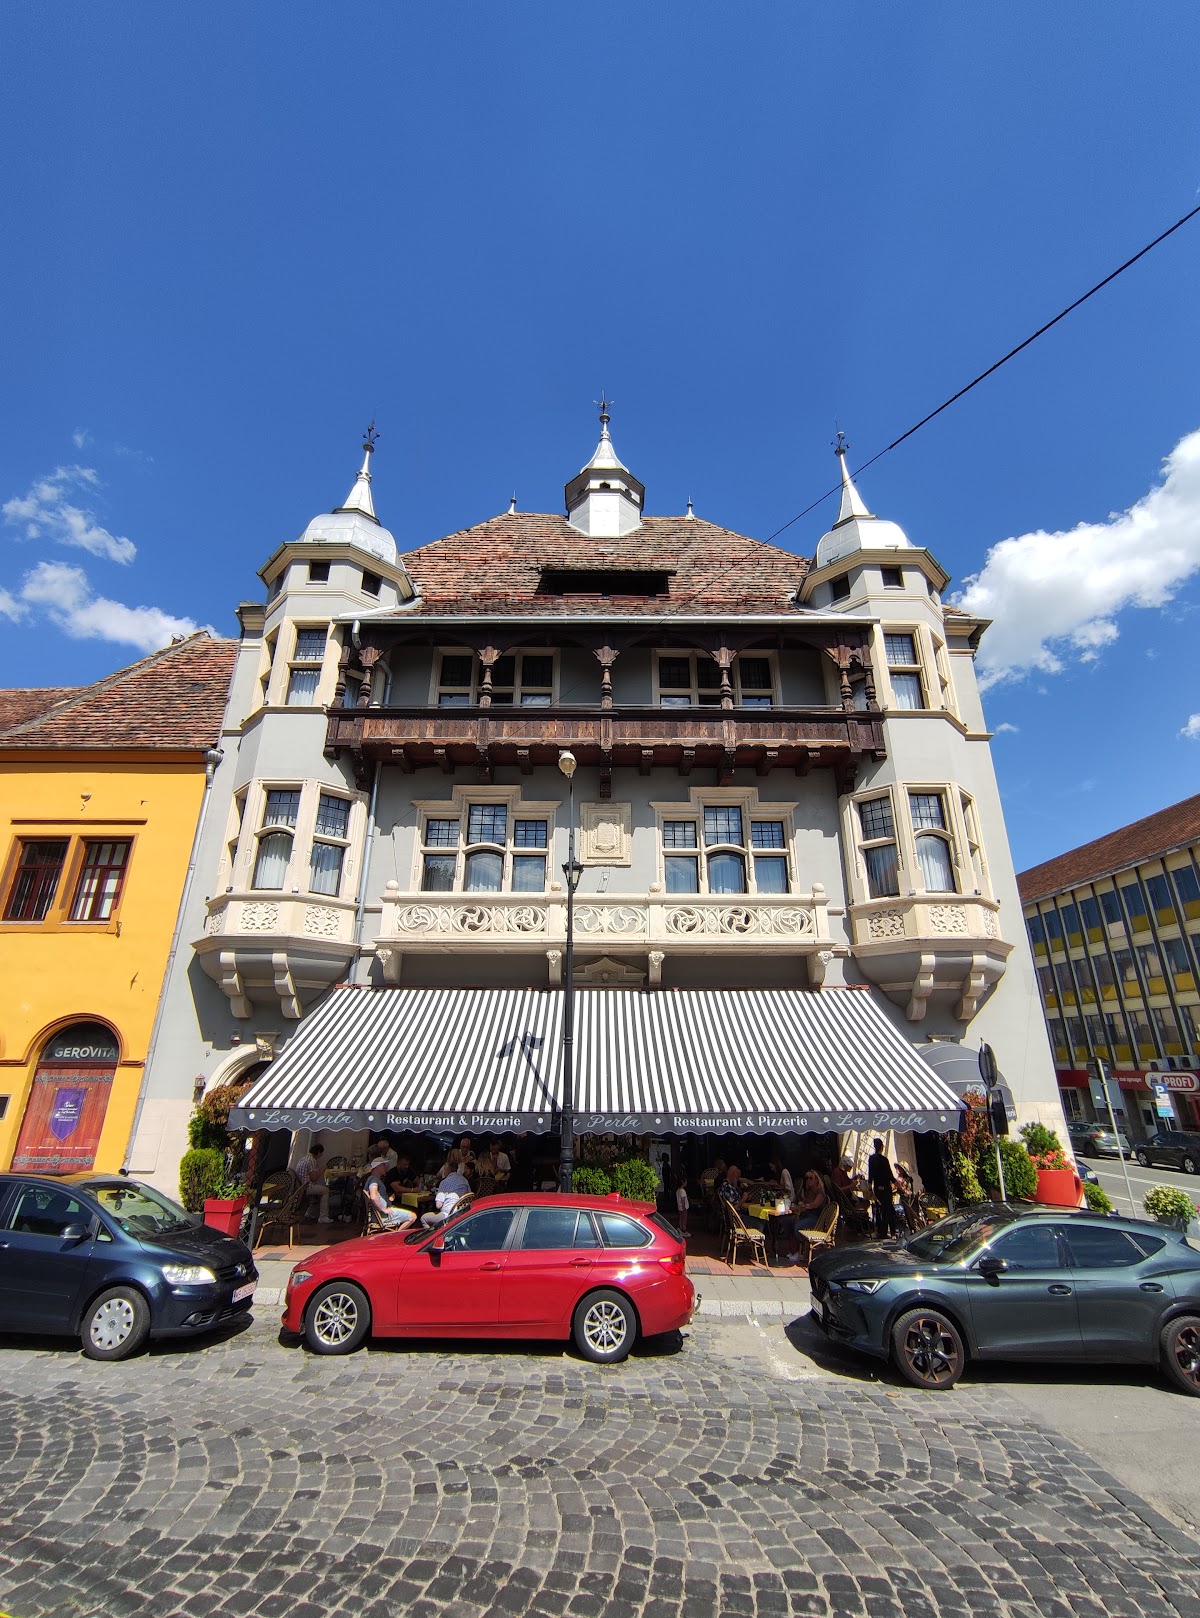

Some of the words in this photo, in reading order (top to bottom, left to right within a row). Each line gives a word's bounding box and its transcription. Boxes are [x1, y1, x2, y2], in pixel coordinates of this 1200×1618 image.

[54, 1046, 117, 1058] GEROVITA
[1164, 1076, 1192, 1088] PROFI
[1155, 1085, 1165, 1097] P
[260, 1110, 293, 1124] La
[299, 1110, 354, 1125] Perla
[386, 1113, 455, 1126] Restaurant
[458, 1114, 468, 1126] &
[471, 1115, 521, 1127] Pizzerie
[587, 1114, 642, 1128] Perla
[673, 1116, 742, 1127] Restaurant
[745, 1116, 755, 1127] &
[758, 1115, 808, 1127] Pizzerie
[836, 1113, 867, 1126] La
[872, 1112, 926, 1127] Perla
